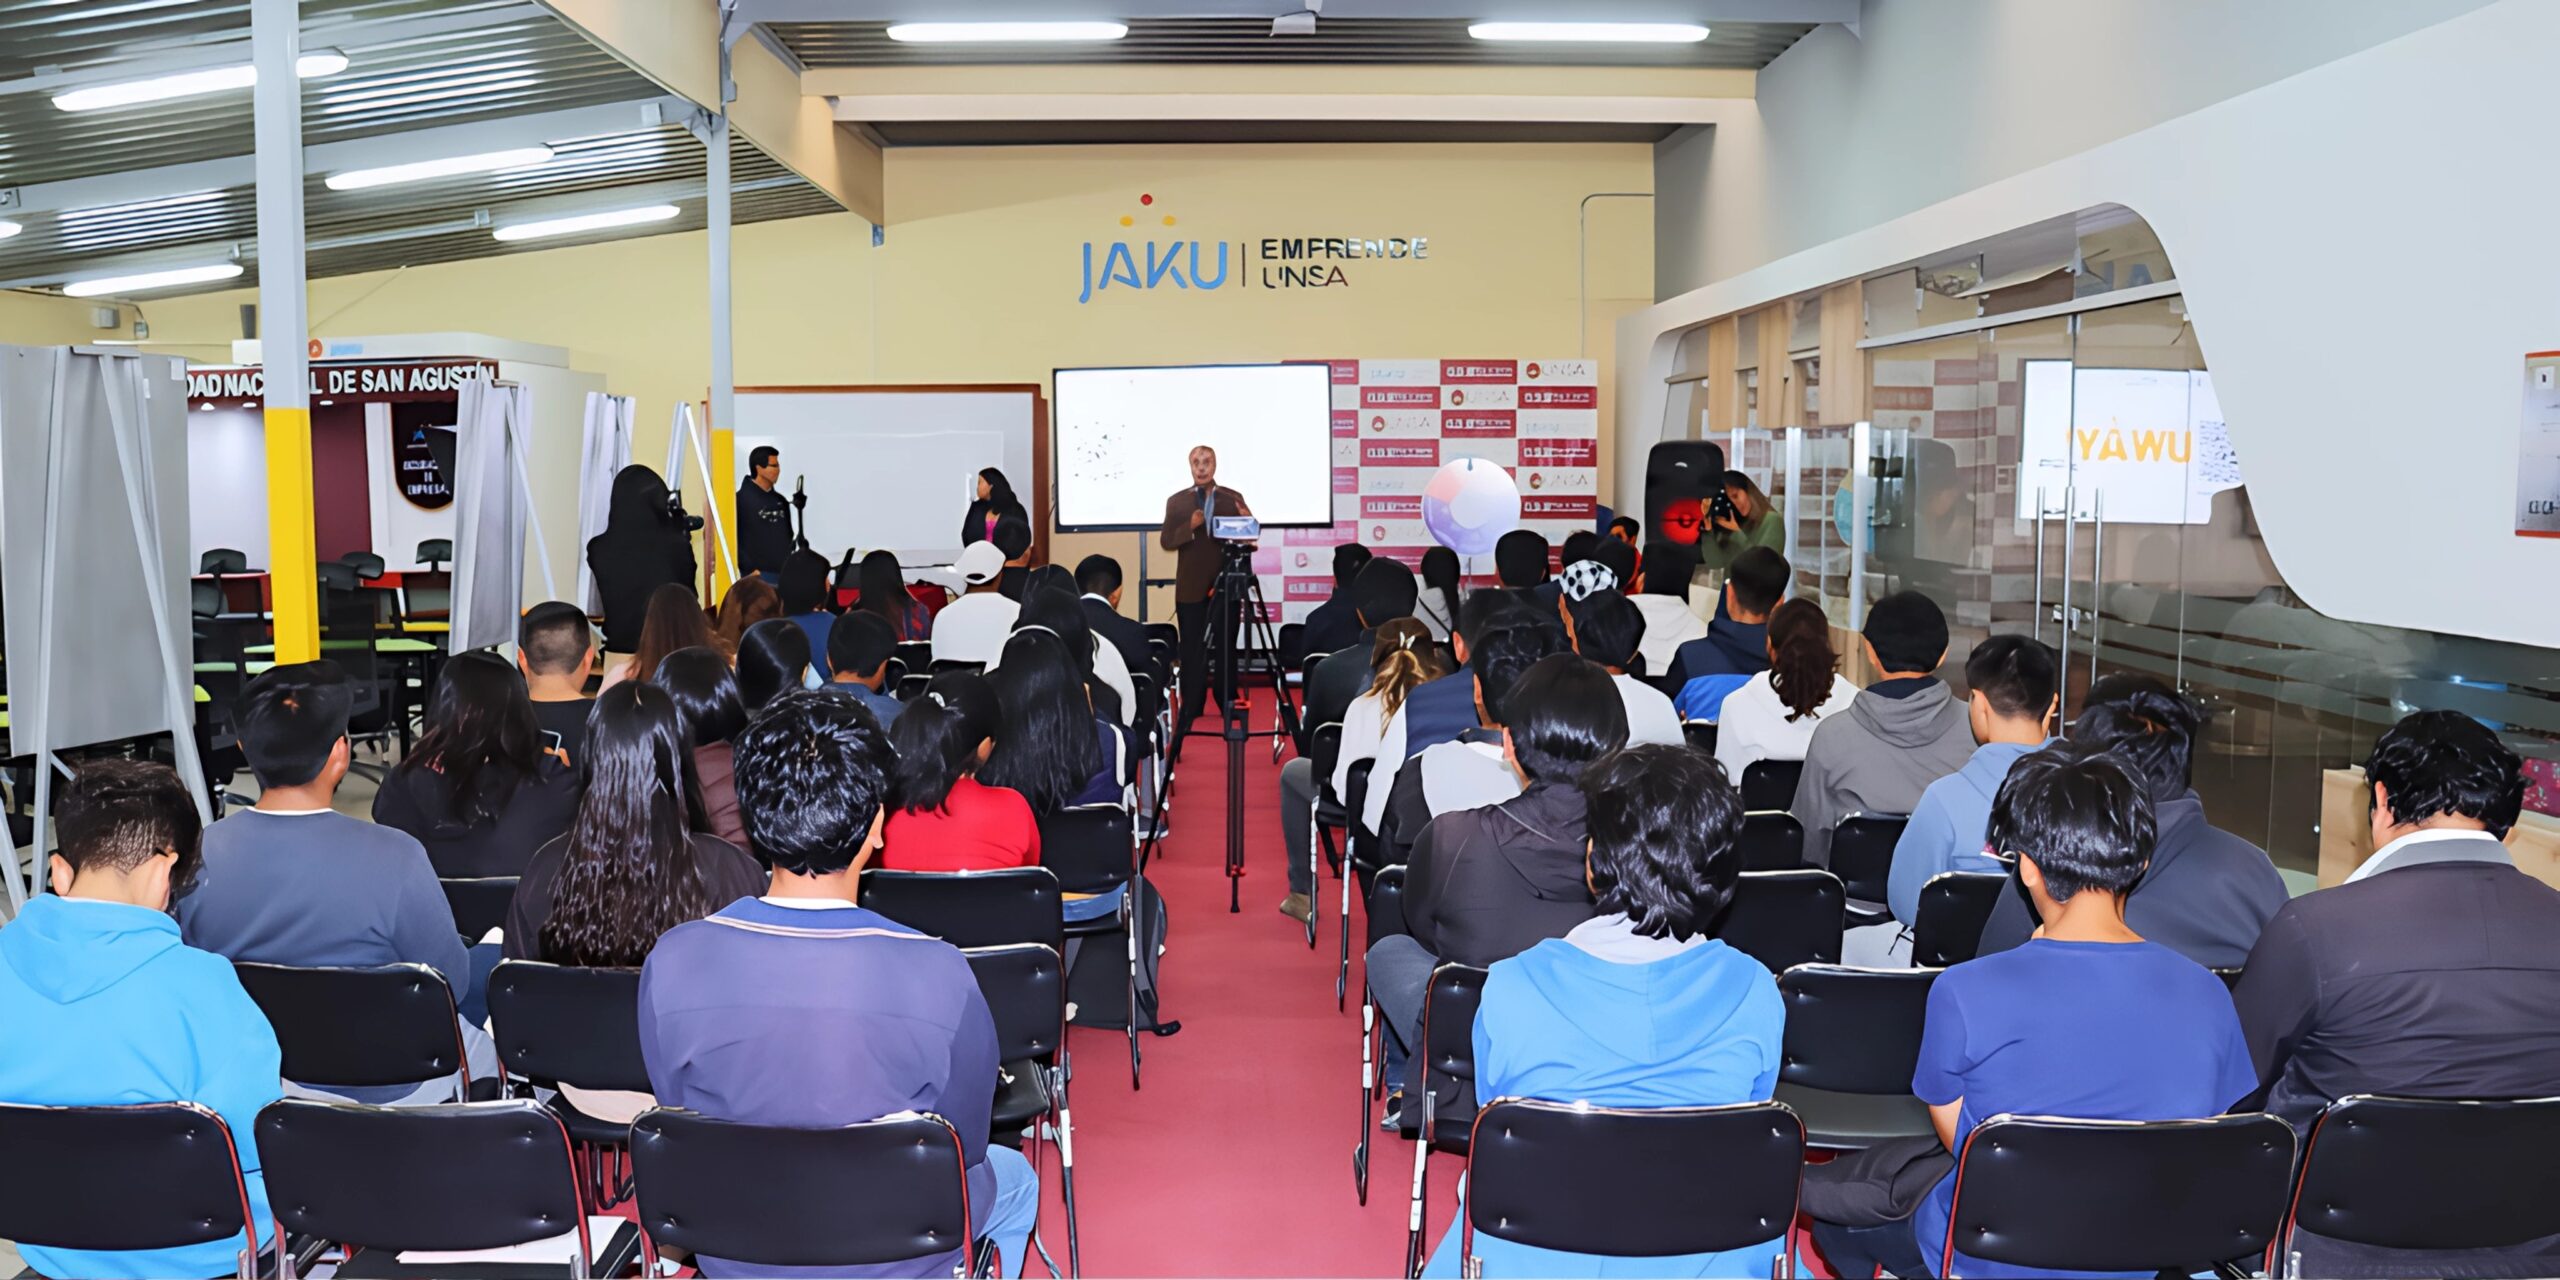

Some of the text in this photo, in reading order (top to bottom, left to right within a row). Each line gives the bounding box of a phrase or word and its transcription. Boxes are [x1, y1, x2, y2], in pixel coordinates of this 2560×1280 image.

[1079, 241, 1227, 304] JAKU
[1263, 265, 1348, 288] UNSA
[329, 370, 357, 394] DE
[361, 368, 404, 392] SAN
